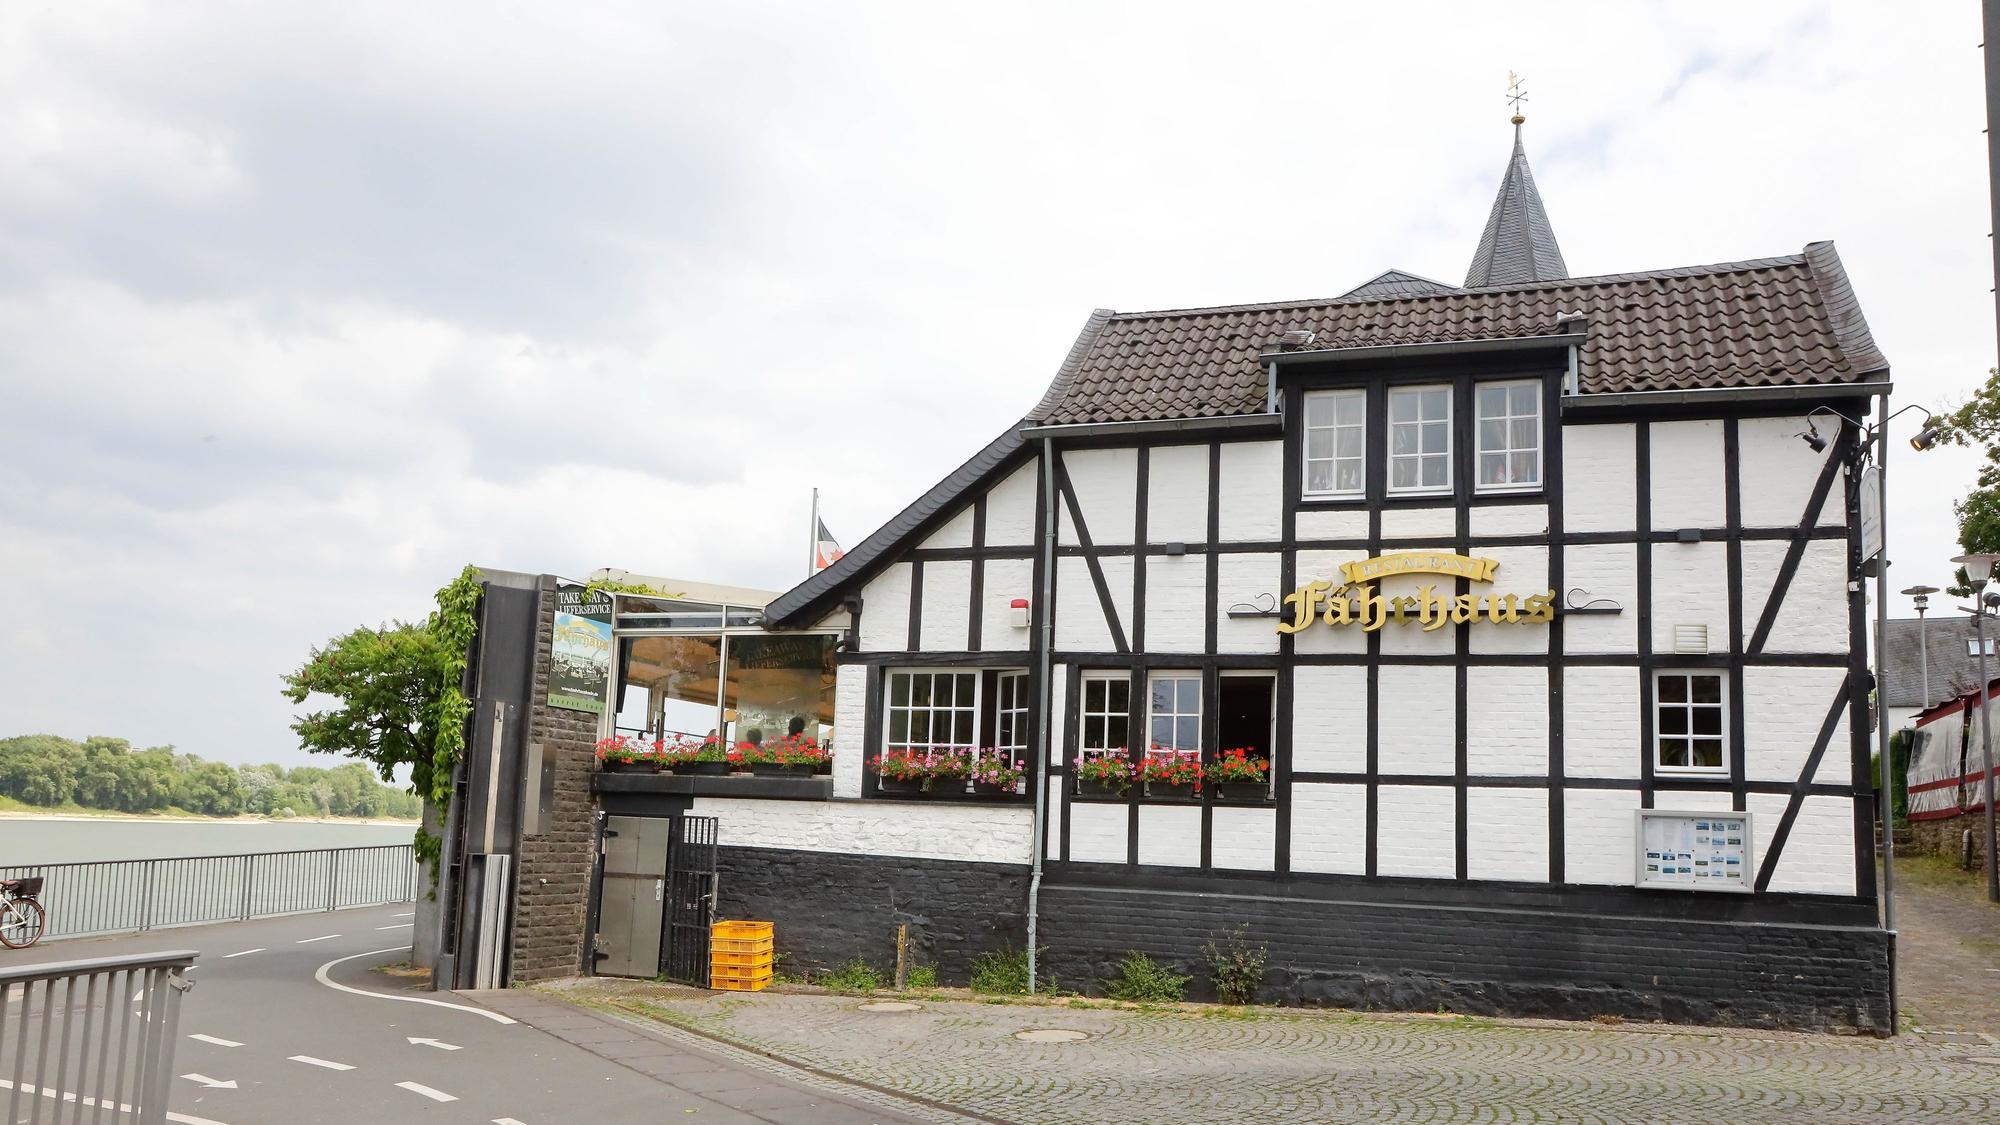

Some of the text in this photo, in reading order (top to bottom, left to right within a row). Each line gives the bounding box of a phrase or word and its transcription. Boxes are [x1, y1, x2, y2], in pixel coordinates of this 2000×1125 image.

[1361, 556, 1475, 577] RESTAURANT
[558, 592, 581, 604] TAKE
[1275, 580, 1555, 635] Fährhaus
